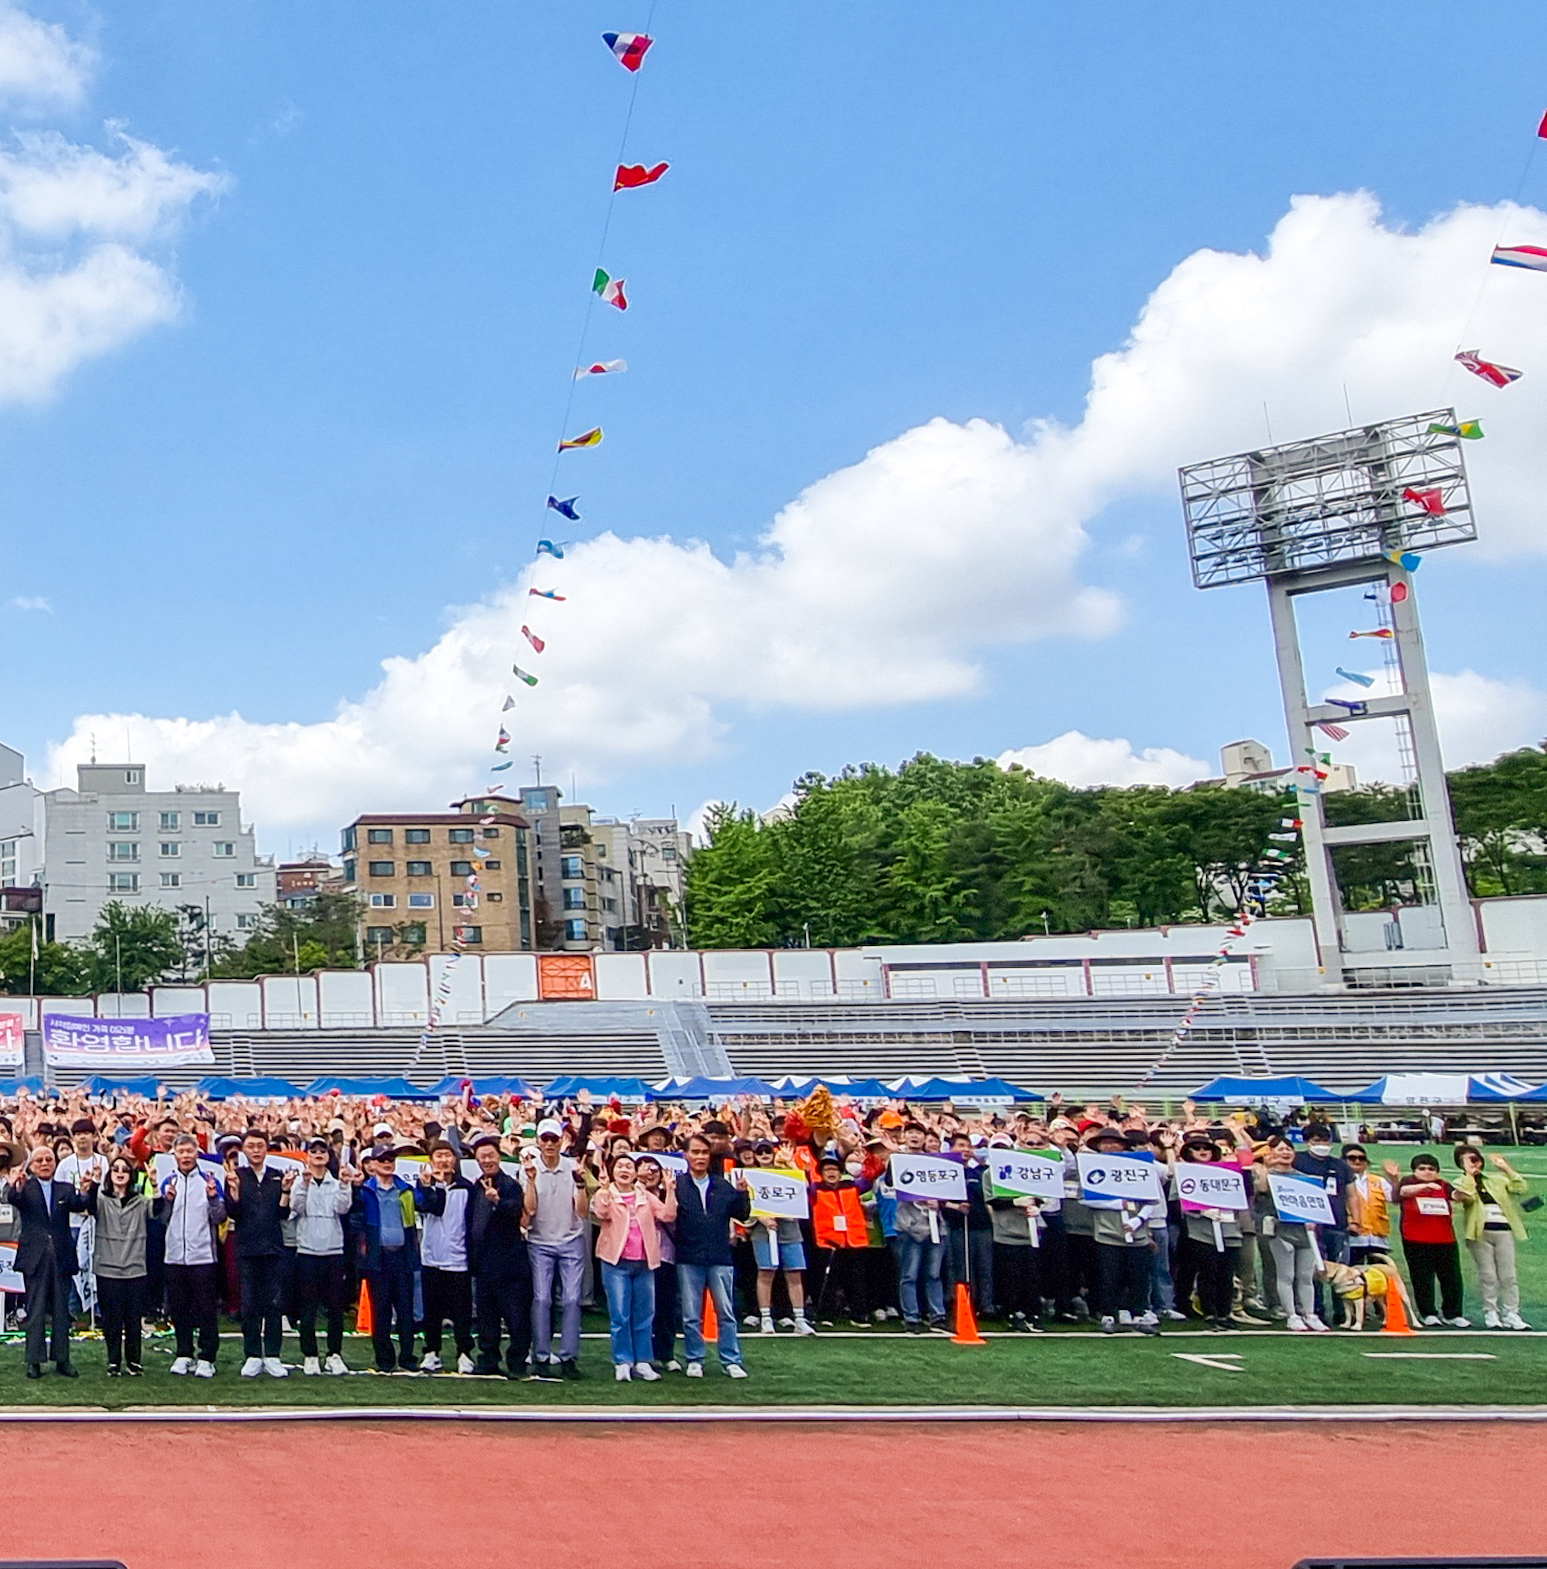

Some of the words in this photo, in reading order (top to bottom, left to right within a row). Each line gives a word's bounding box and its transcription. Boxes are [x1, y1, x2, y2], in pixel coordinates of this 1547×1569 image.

[580, 971, 593, 989] A
[48, 1028, 204, 1053] 환영합니다
[915, 1169, 959, 1182] 영등포구
[1017, 1166, 1054, 1180] 강남구
[1110, 1168, 1150, 1182] 광진구
[1199, 1178, 1241, 1192] 동대문구
[757, 1186, 797, 1200] 종로구
